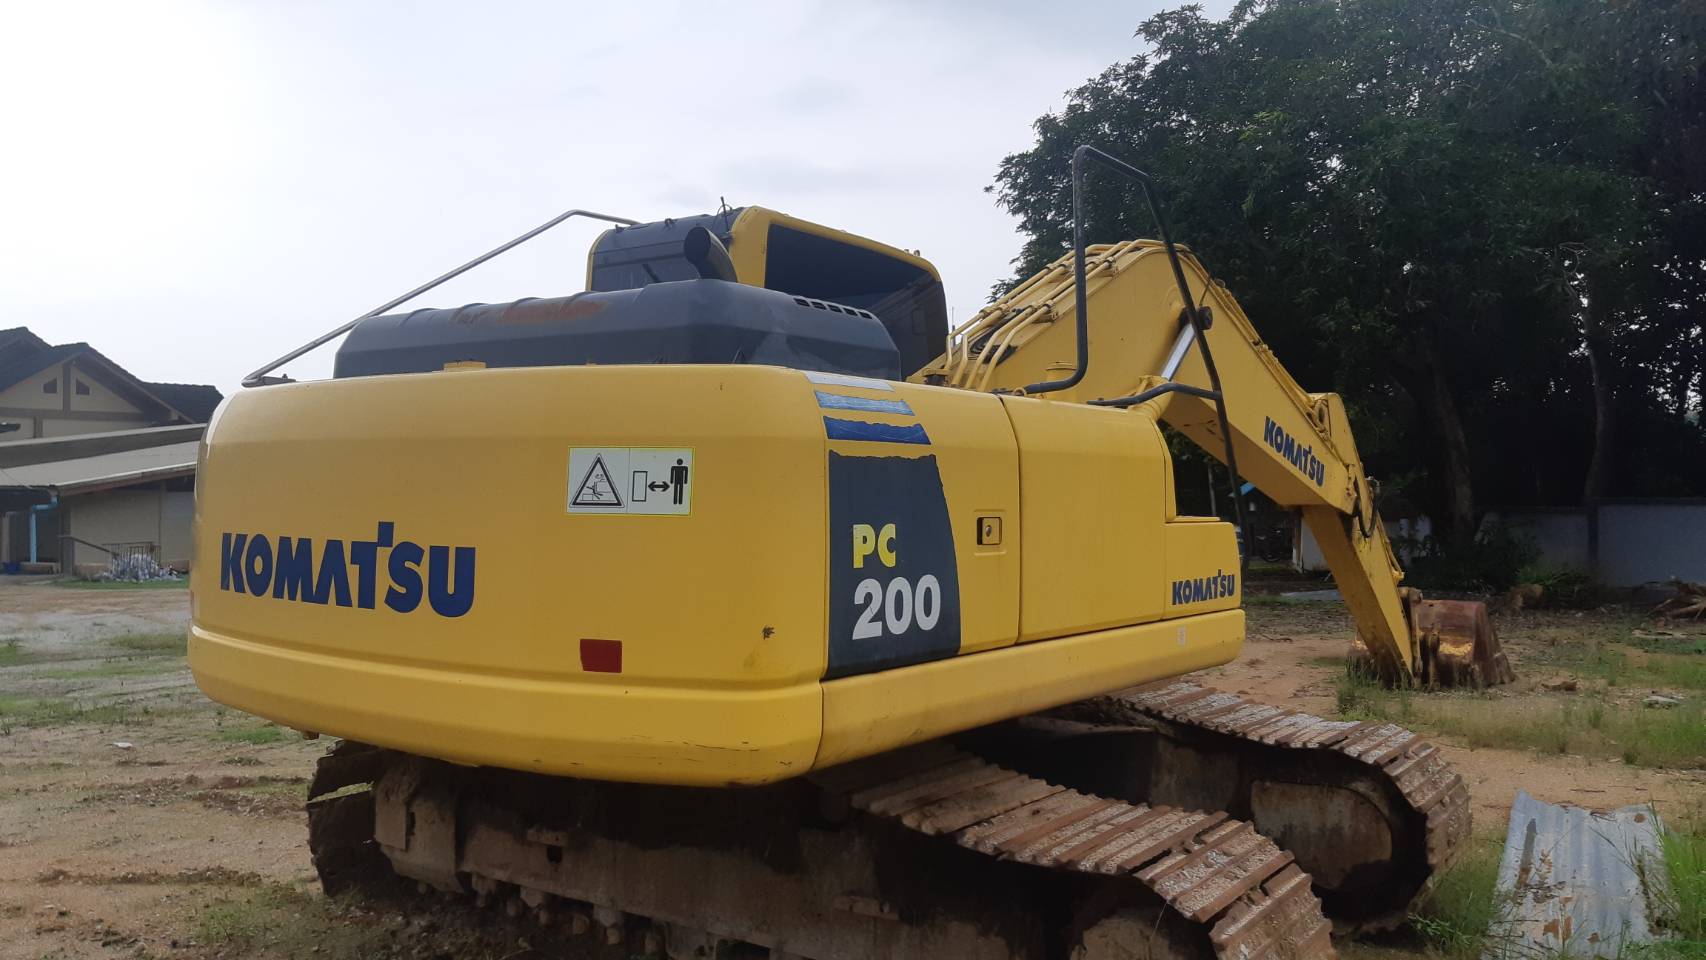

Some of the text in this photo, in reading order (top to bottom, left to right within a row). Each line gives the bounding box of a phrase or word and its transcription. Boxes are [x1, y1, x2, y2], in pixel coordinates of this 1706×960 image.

[1264, 416, 1325, 487] KOMATSU
[221, 521, 476, 617] KOMATSU
[852, 523, 897, 569] PC
[851, 573, 941, 640] 200
[1171, 569, 1236, 606] KOMATSU
